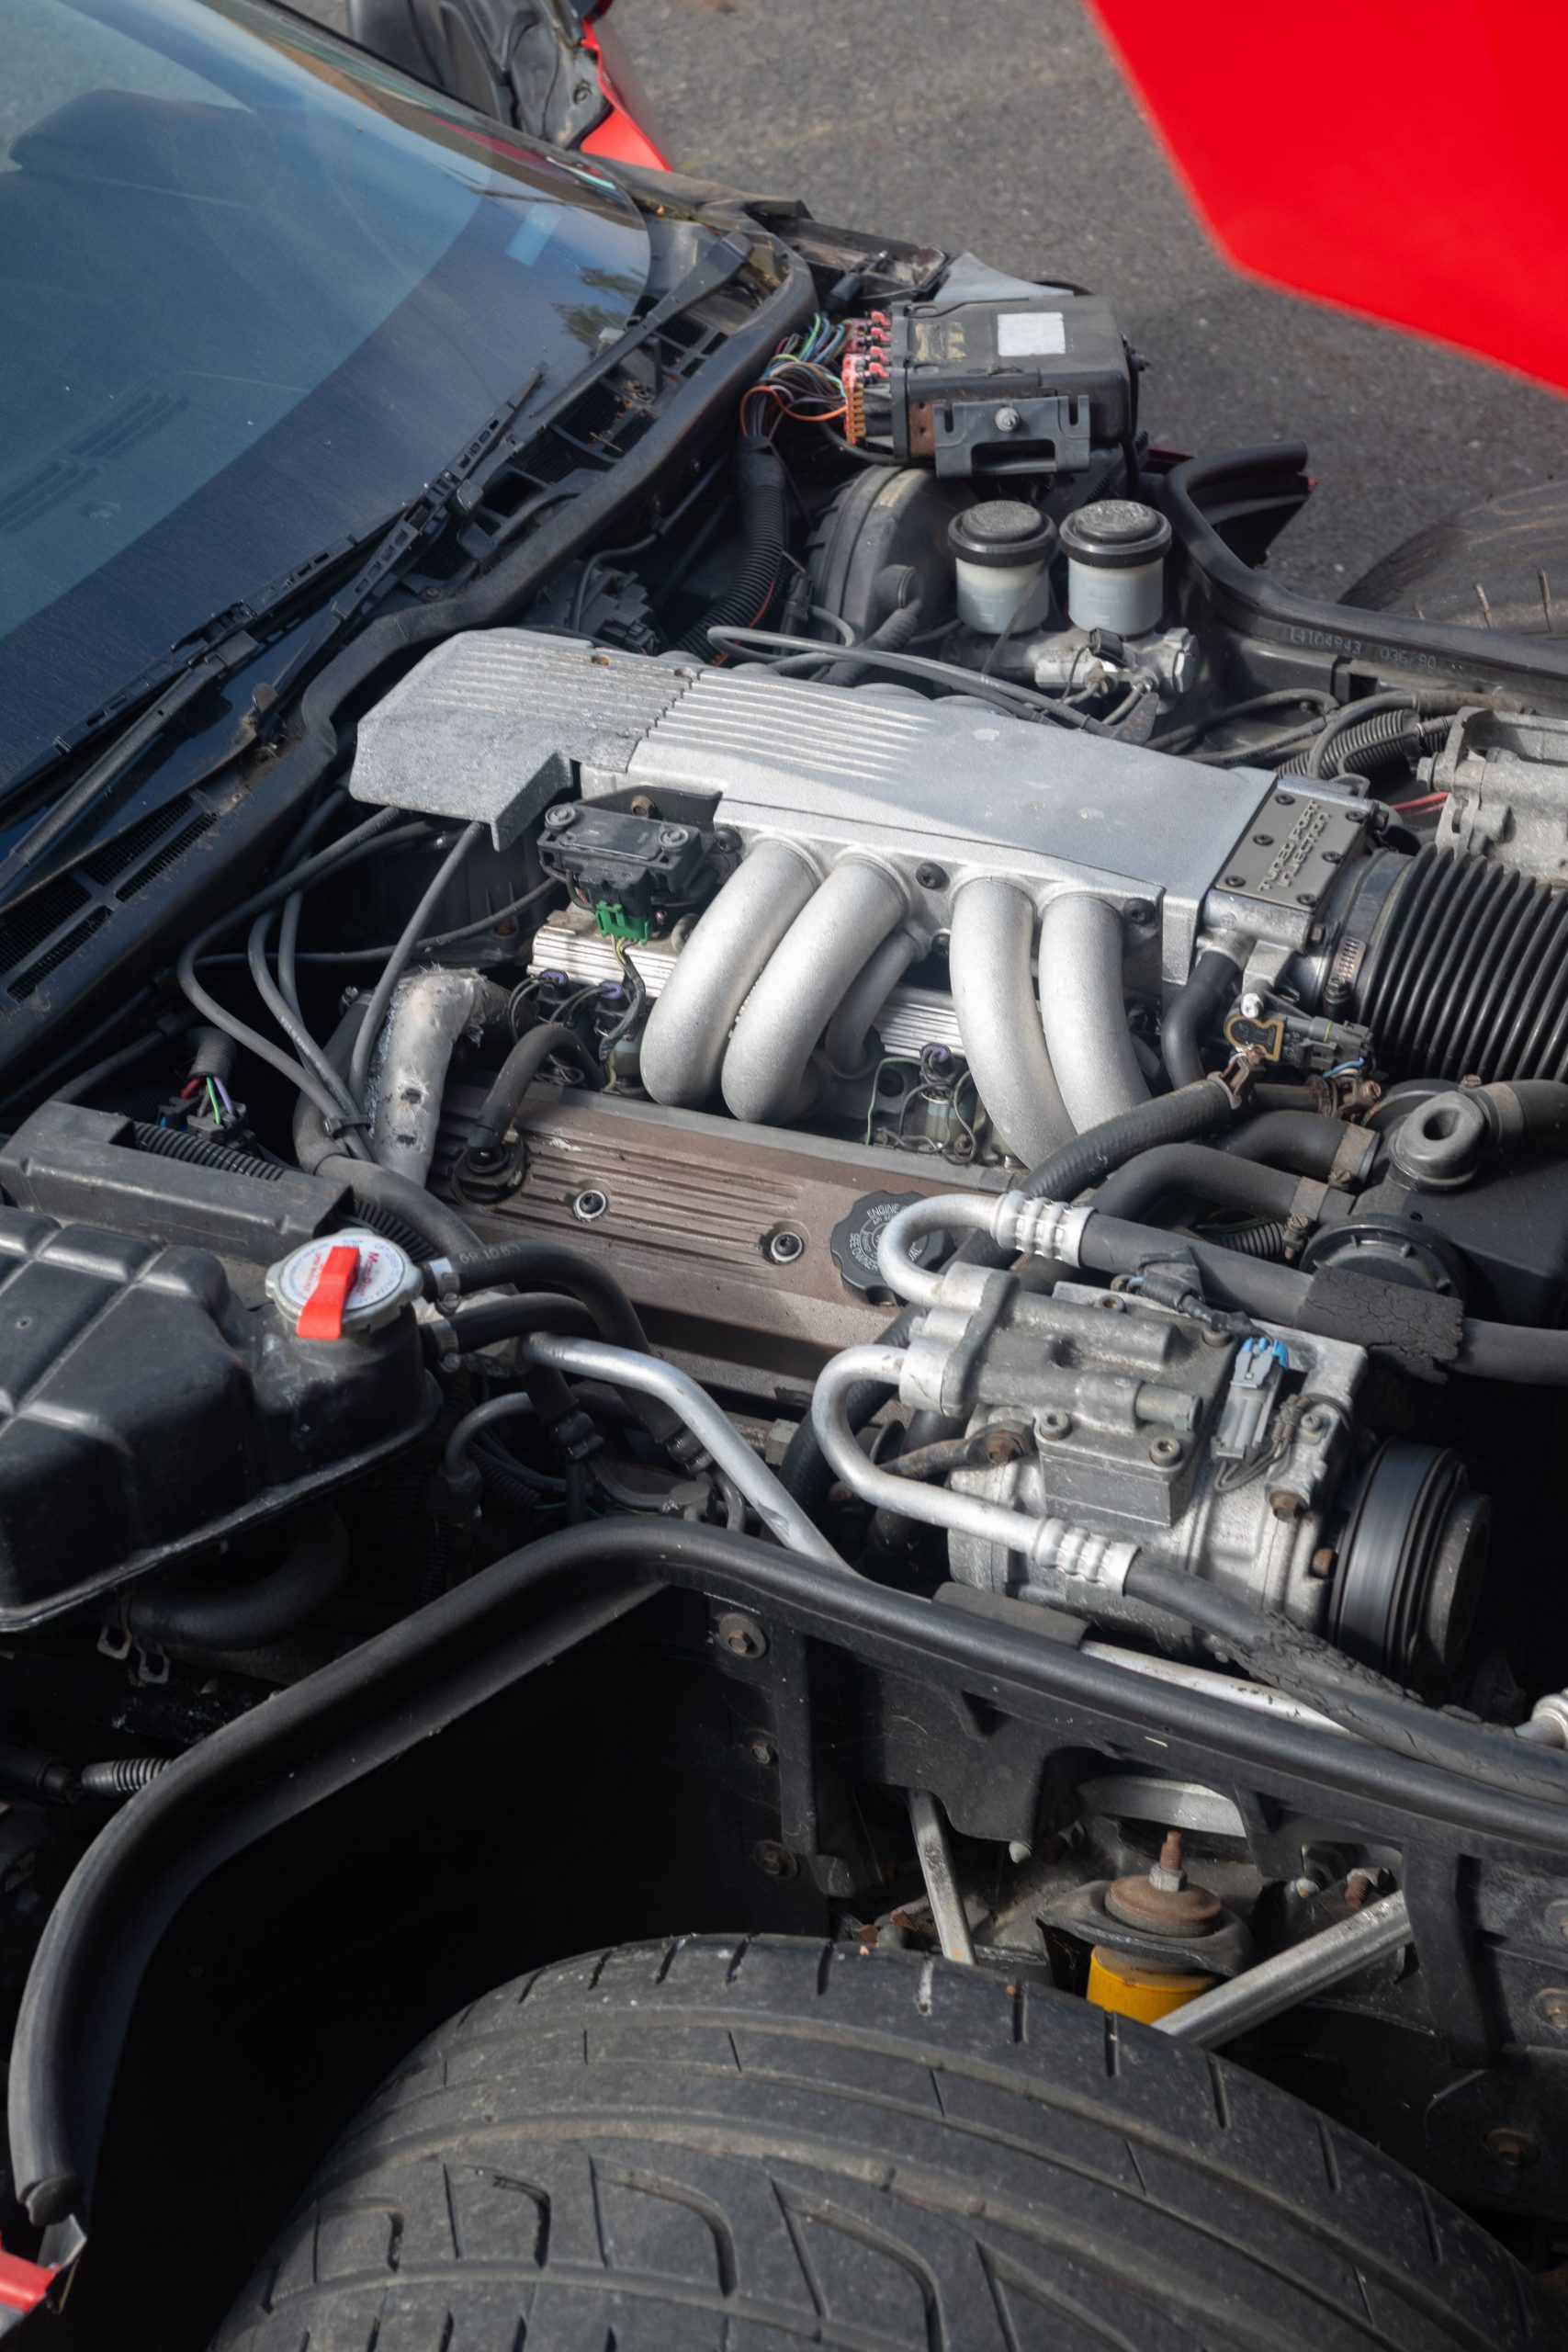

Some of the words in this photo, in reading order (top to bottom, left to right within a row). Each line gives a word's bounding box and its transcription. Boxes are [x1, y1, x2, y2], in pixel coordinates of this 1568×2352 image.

[1257, 842, 1295, 891] TUNED
[1288, 799, 1321, 842] PORT
[1277, 811, 1332, 888] INJECTION
